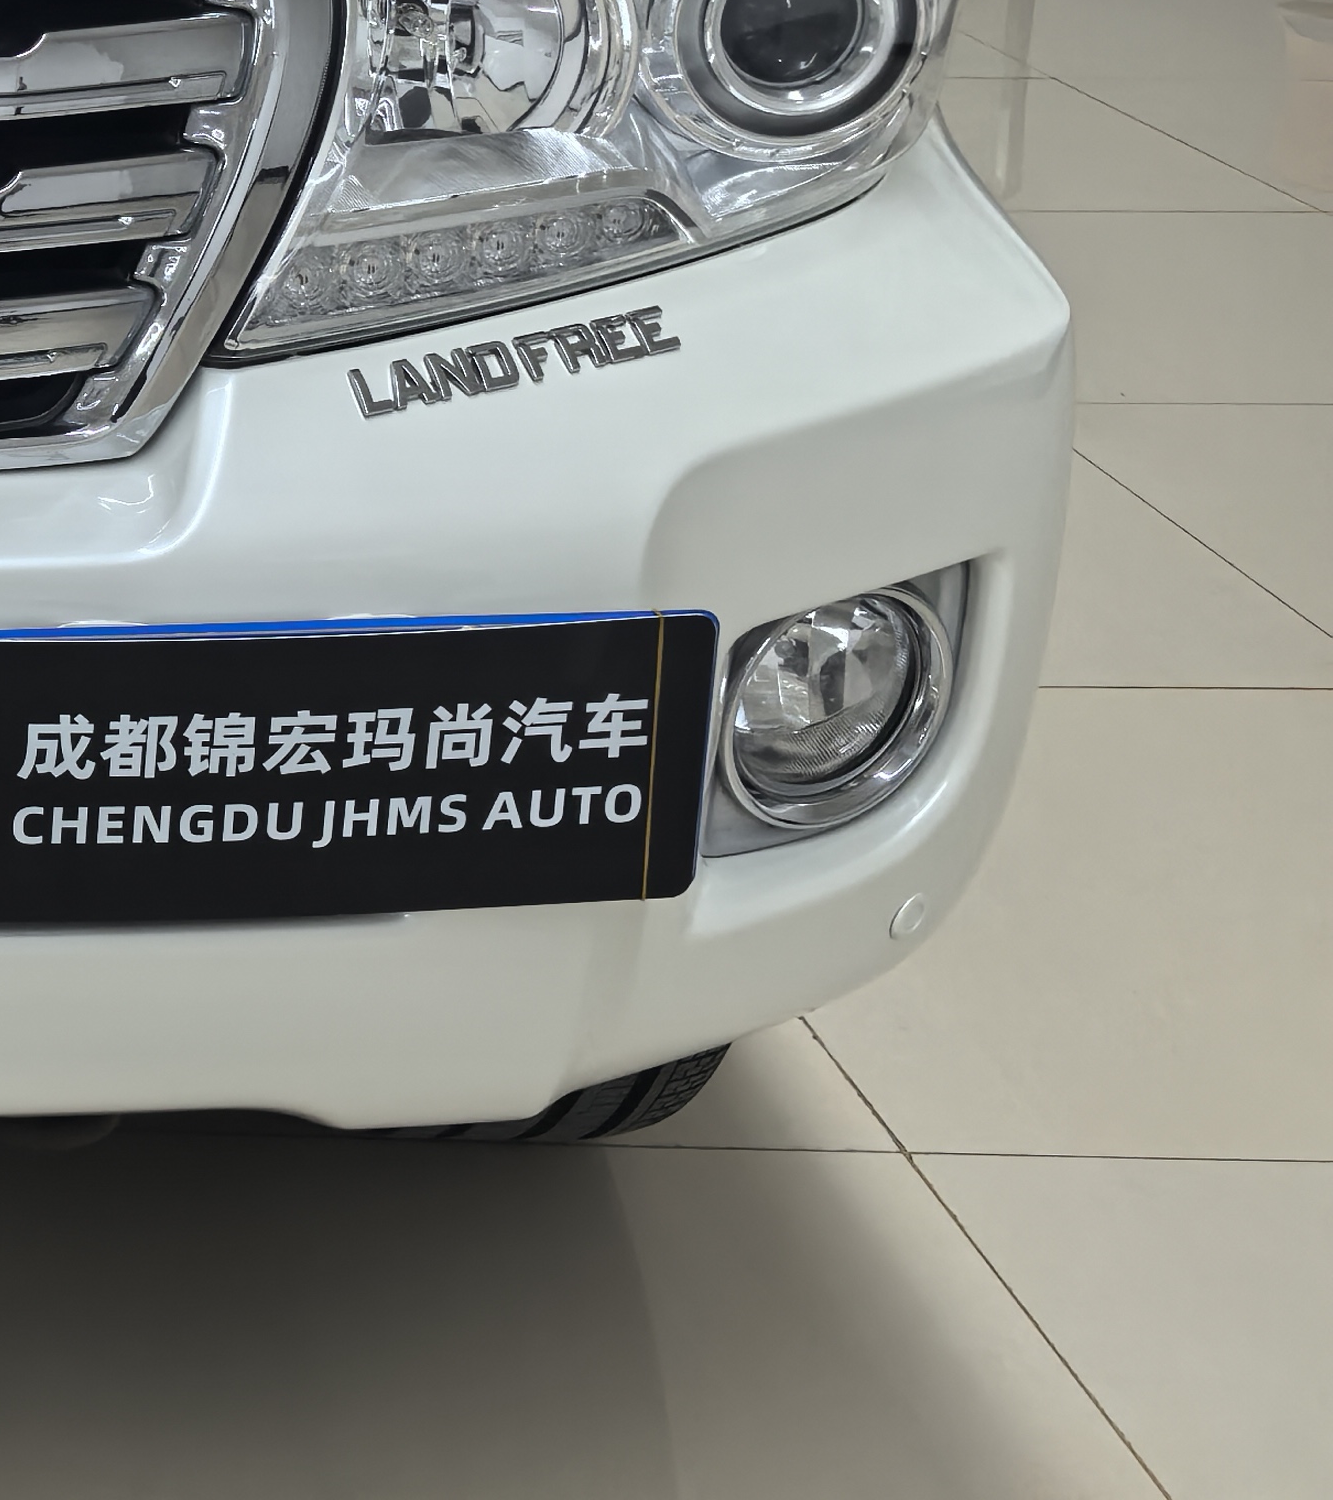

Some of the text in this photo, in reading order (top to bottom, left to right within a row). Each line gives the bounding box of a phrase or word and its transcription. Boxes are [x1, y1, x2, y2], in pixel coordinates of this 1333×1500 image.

[16, 693, 650, 780] 成都锦宏玛尚汽车
[12, 783, 643, 849] CHENGDU JHMS AUTO
